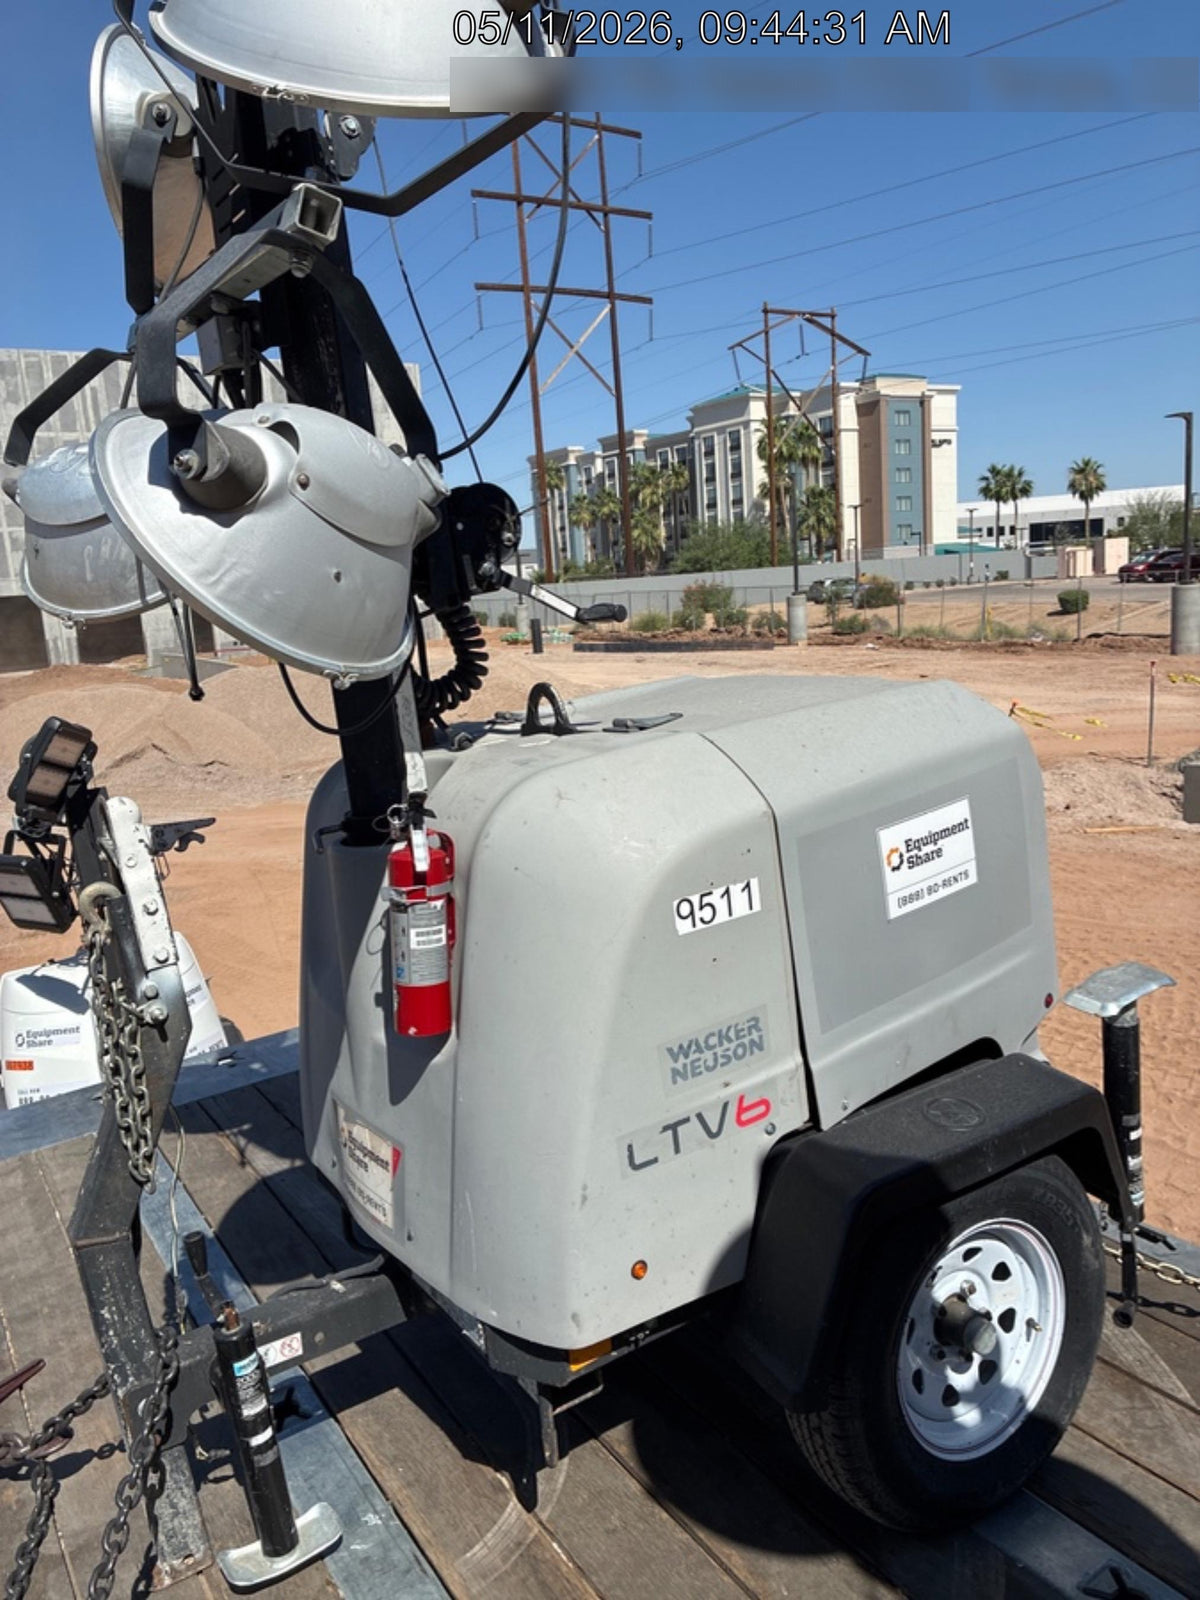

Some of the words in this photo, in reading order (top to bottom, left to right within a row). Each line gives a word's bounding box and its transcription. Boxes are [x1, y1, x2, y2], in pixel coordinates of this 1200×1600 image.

[904, 819, 970, 852] Equipment
[906, 847, 943, 869] Share
[676, 880, 755, 928] 9511
[25, 1026, 81, 1040] Equipment
[26, 1038, 54, 1049] Share
[665, 1016, 764, 1065] WACKER
[670, 1034, 766, 1086] NEUSON
[626, 1094, 772, 1171] LTV6
